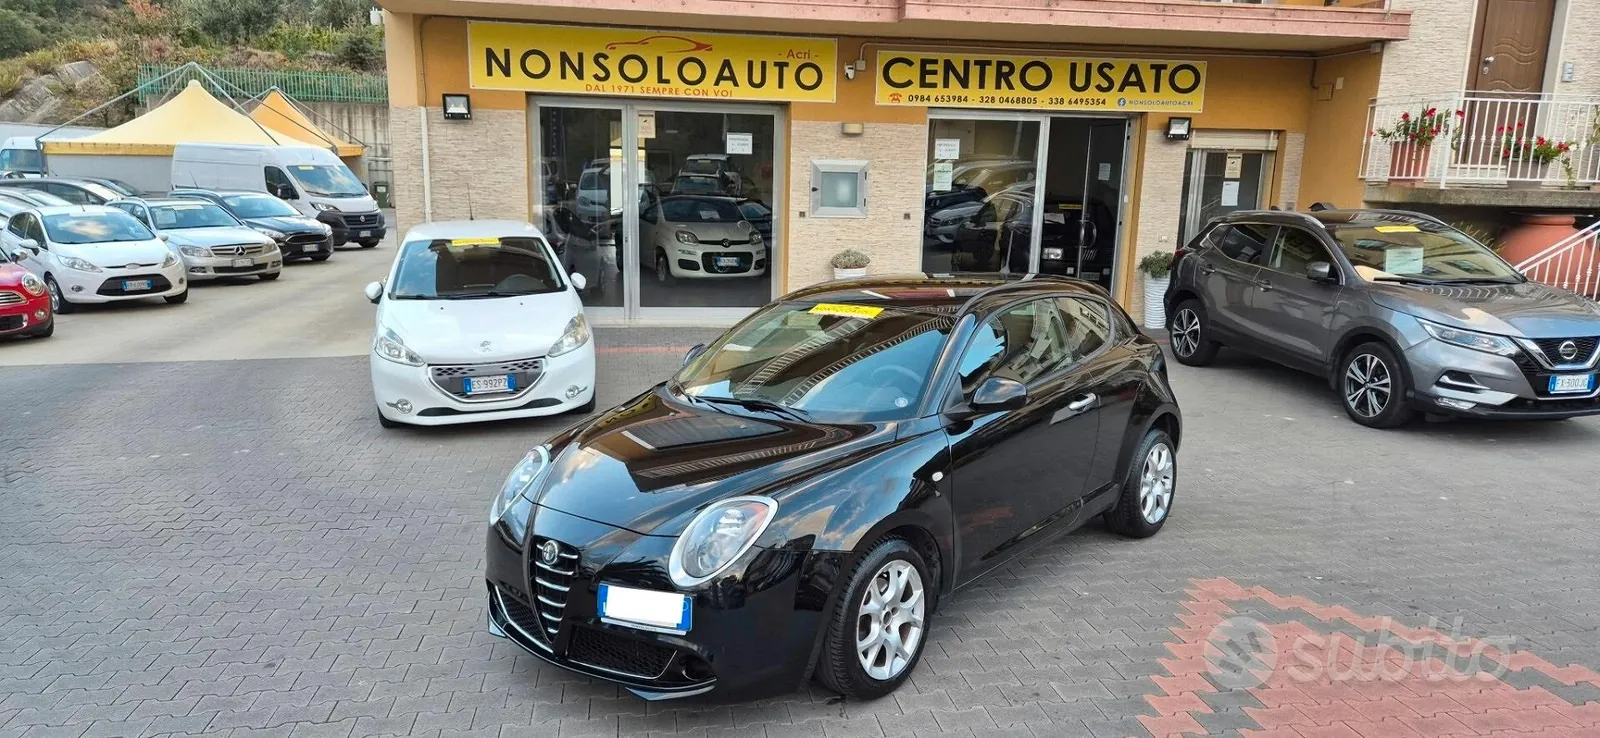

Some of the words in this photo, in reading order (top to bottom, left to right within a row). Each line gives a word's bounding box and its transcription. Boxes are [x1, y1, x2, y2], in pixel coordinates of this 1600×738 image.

[786, 48, 811, 60] Acri
[485, 47, 823, 91] NONSOLOAUTO
[882, 56, 1053, 92] CENTRO
[1069, 61, 1201, 94] USATO
[585, 83, 605, 92] DAL
[611, 84, 635, 94] 1971
[640, 86, 680, 96] SEMPRE
[684, 88, 709, 97] CON
[713, 89, 733, 98] VOI
[908, 94, 931, 103] 0984
[934, 95, 968, 104] 653984
[979, 95, 996, 104] 328
[998, 96, 1038, 105] 0468805
[1048, 97, 1065, 106] 338
[1067, 98, 1106, 106] 6495354
[471, 380, 481, 390] ES
[483, 378, 507, 389] 992PZ
